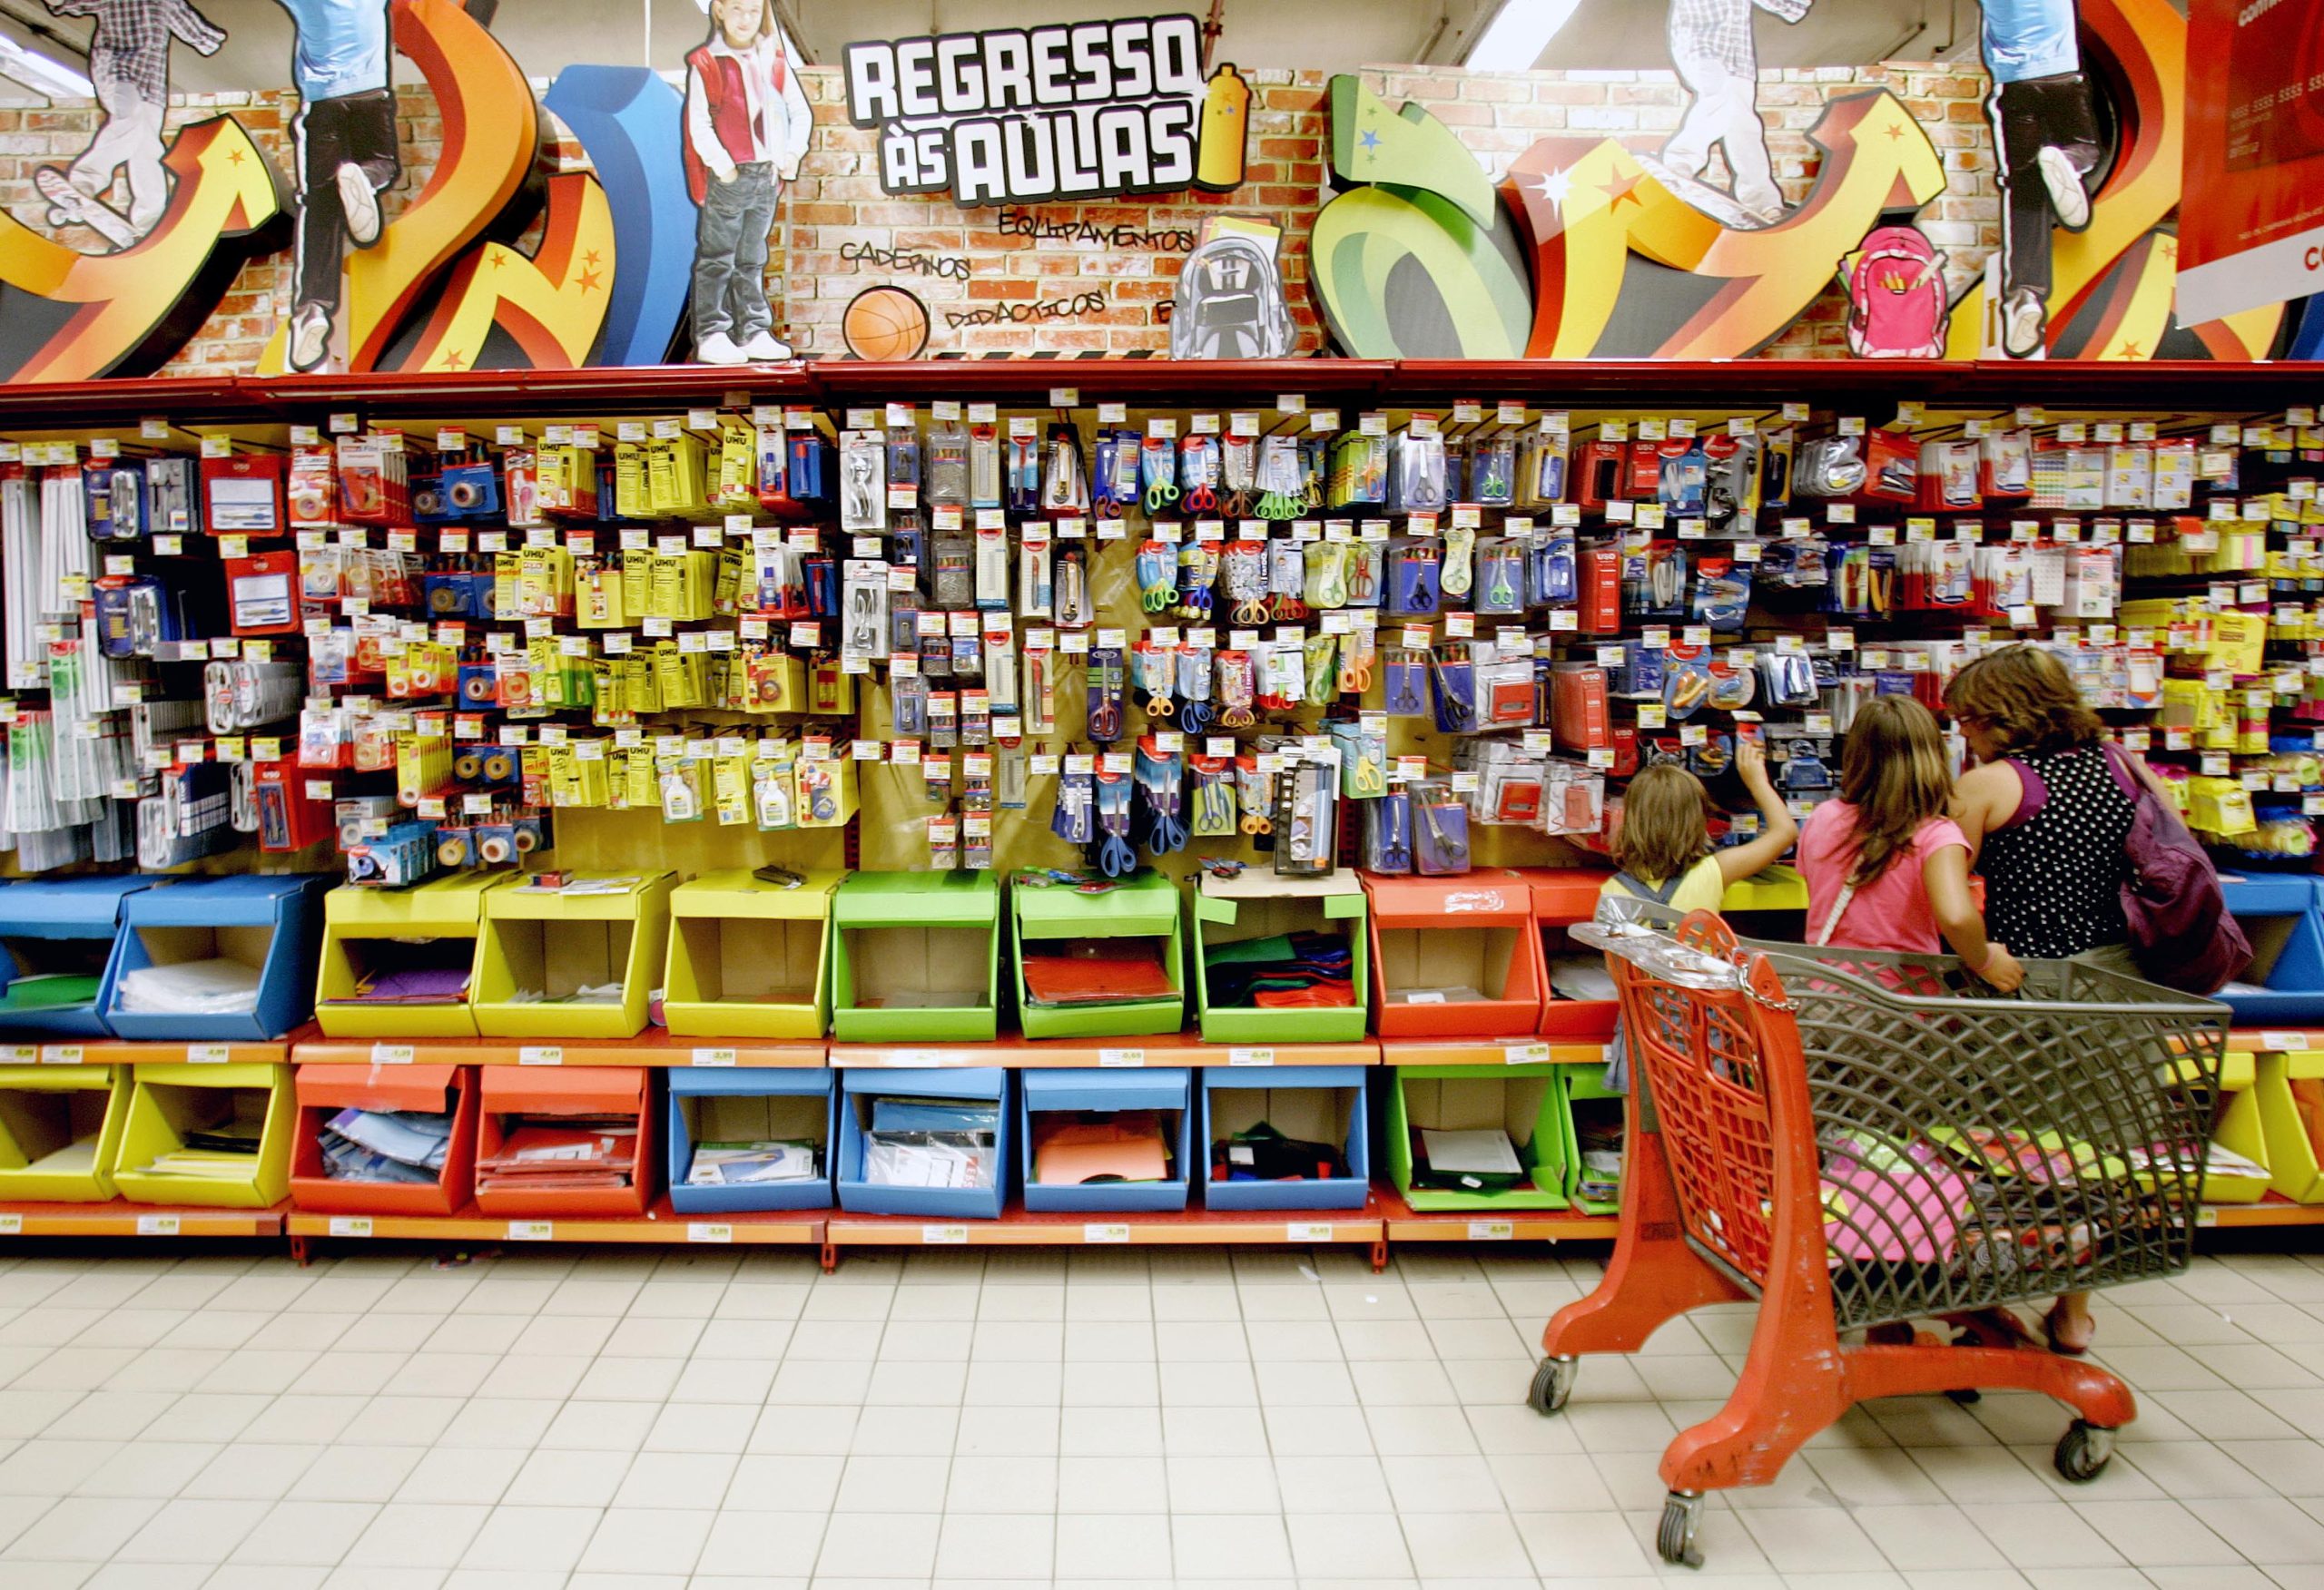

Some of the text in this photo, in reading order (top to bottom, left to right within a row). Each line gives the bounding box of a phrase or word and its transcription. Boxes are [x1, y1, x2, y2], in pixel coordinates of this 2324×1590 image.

[848, 18, 1200, 121] REGRESSO
[883, 105, 1193, 201] ÀS AULAS
[999, 206, 1195, 252] EQUIPAMENTOS
[841, 241, 970, 280] CADERNOS
[945, 290, 1106, 329] DIDACTICOS
[725, 436, 746, 445] UHU
[651, 445, 670, 453] UHU
[1596, 443, 1617, 453] USO
[1636, 443, 1655, 452] USO
[524, 550, 545, 558] UHU
[1596, 553, 1616, 561] USO
[551, 748, 571, 756] UHU
[630, 747, 650, 755] UHU
